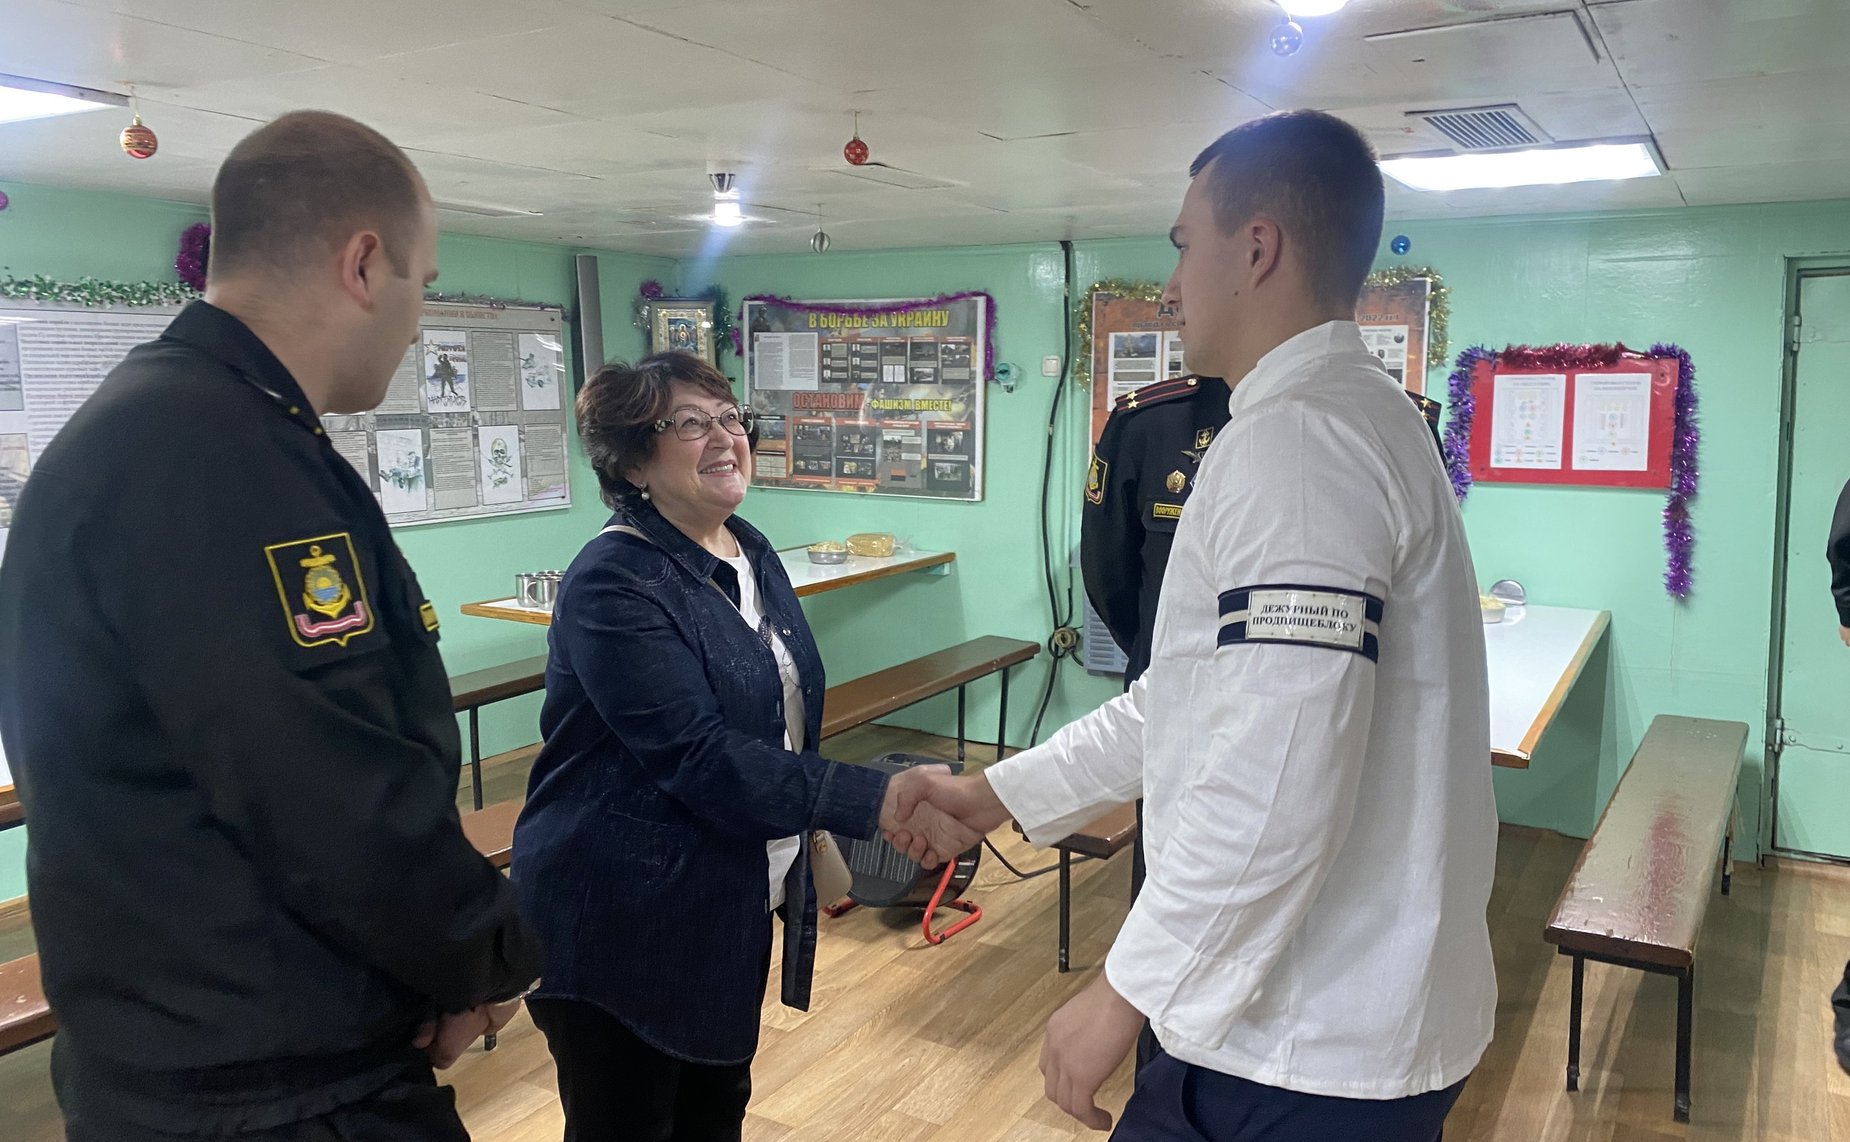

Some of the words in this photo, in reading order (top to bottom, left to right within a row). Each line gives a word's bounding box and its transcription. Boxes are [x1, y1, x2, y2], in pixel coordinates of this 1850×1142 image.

[808, 313, 817, 328] В
[890, 310, 949, 327] УКРАИНУ
[793, 392, 865, 409] ОСТАНОВИМ
[871, 399, 911, 410] ФАШИЗМ
[915, 400, 952, 411] ВМЕСТЕ!
[1261, 604, 1328, 617] ДЕЖУРНЫЙ
[1332, 607, 1349, 619] ПО
[1252, 617, 1357, 632] ПРОДПИЩЕБЛОКУ
